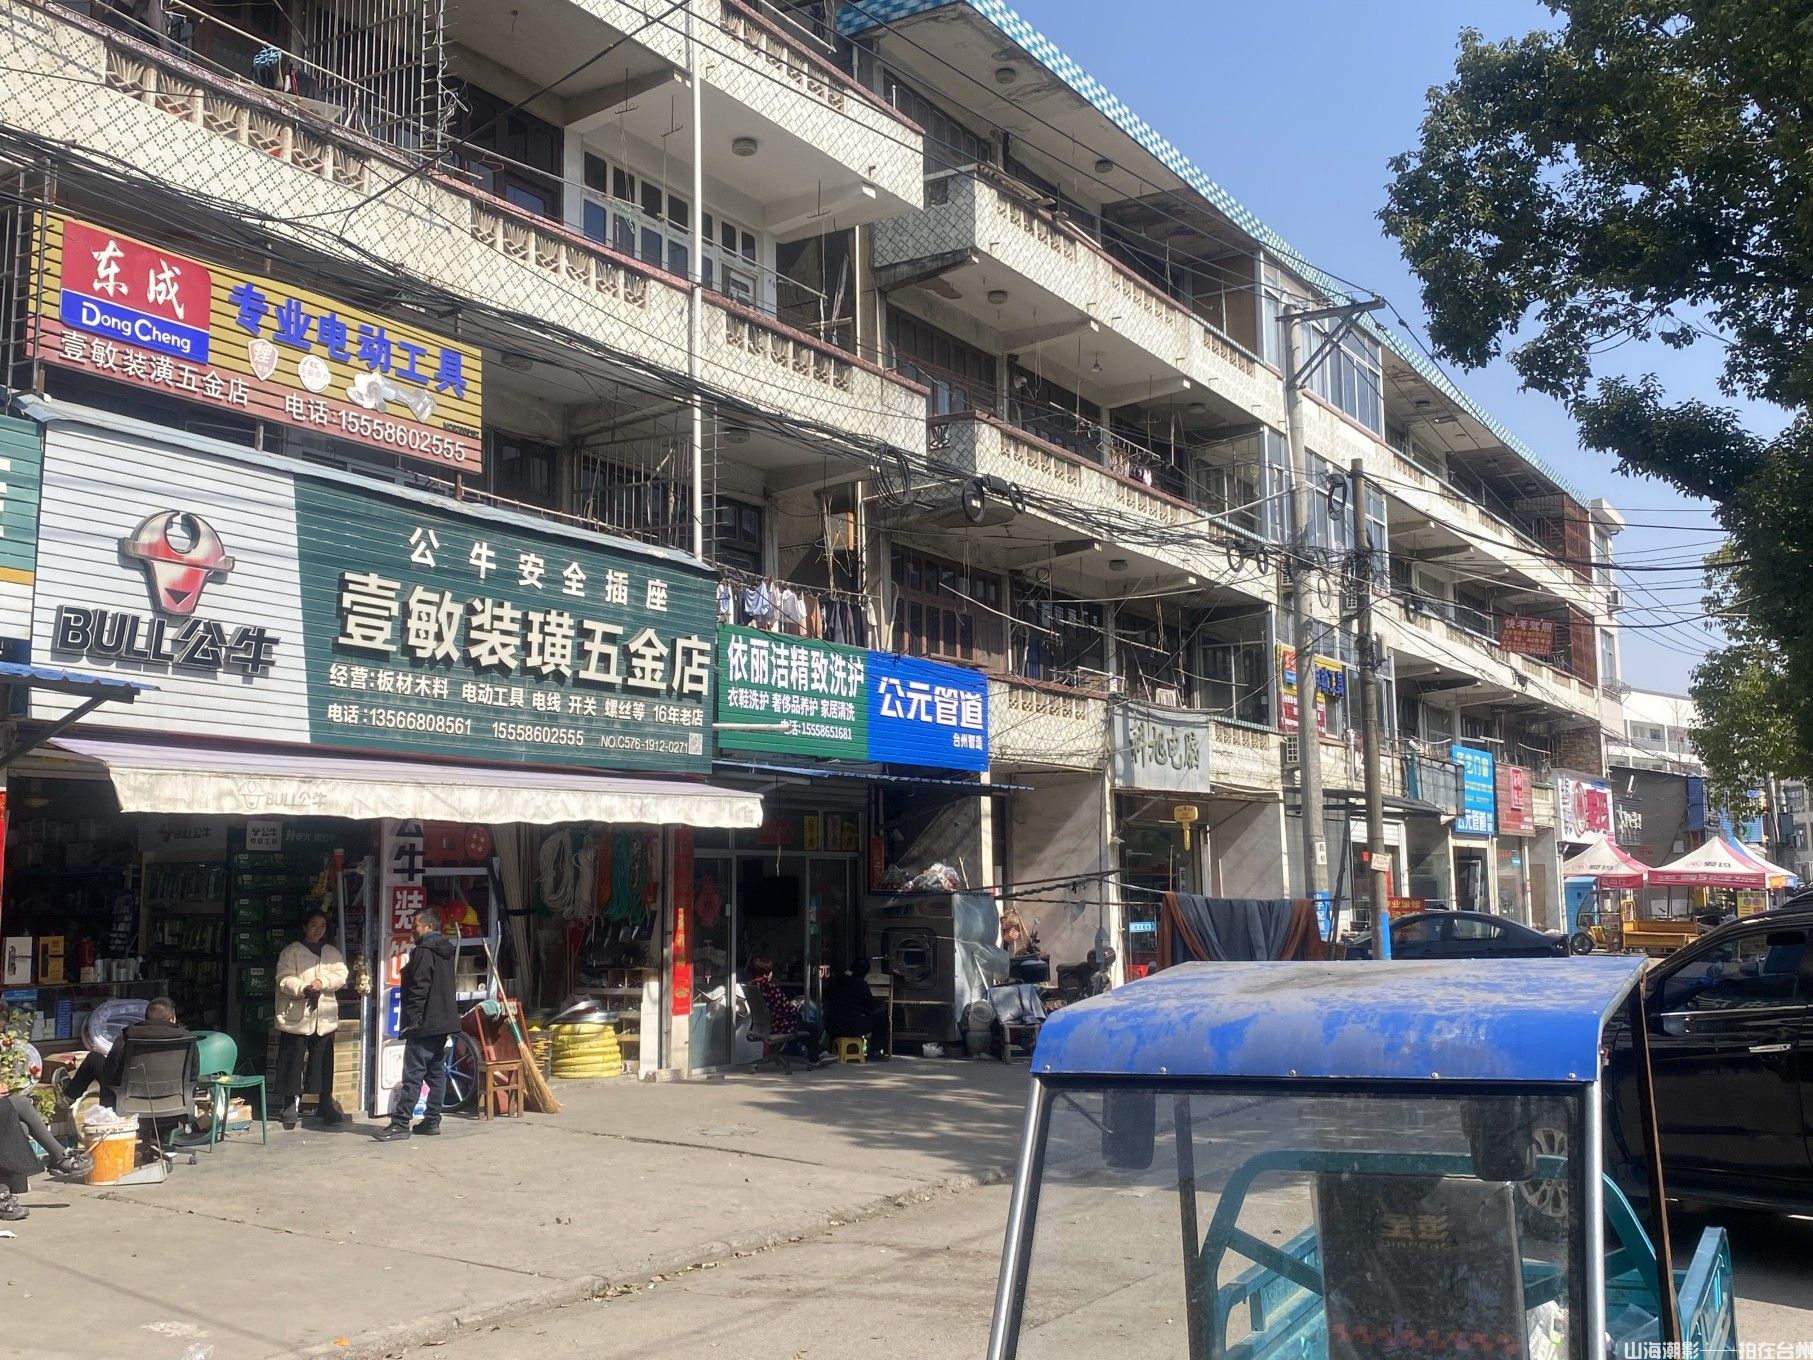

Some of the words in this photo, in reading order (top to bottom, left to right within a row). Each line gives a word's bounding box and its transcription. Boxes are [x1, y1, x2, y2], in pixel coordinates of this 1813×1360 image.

[92, 239, 186, 320] 东成
[59, 330, 250, 407] 壹敏装潢五金店
[228, 282, 468, 400] 专业电动工具
[284, 392, 466, 463] 电话:15558602555
[408, 527, 668, 612] 公牛安全插座
[338, 571, 711, 696] 壹敏装璜五金店
[728, 634, 864, 698] 依丽洁精致洗护
[327, 703, 472, 736] 电话:13566808561
[491, 720, 585, 747] 15558602555
[329, 662, 449, 700] 经营:板材木料
[462, 681, 525, 708] 电动工具
[532, 690, 562, 712] 电线
[568, 694, 597, 717] 开关
[604, 697, 646, 721] 螺丝等
[652, 704, 704, 727] 16年老店
[727, 688, 769, 712] 衣鞋洗护
[772, 692, 819, 719] 奢侈品养护
[820, 699, 856, 723] 家居清洗
[878, 676, 984, 730] 公元管道
